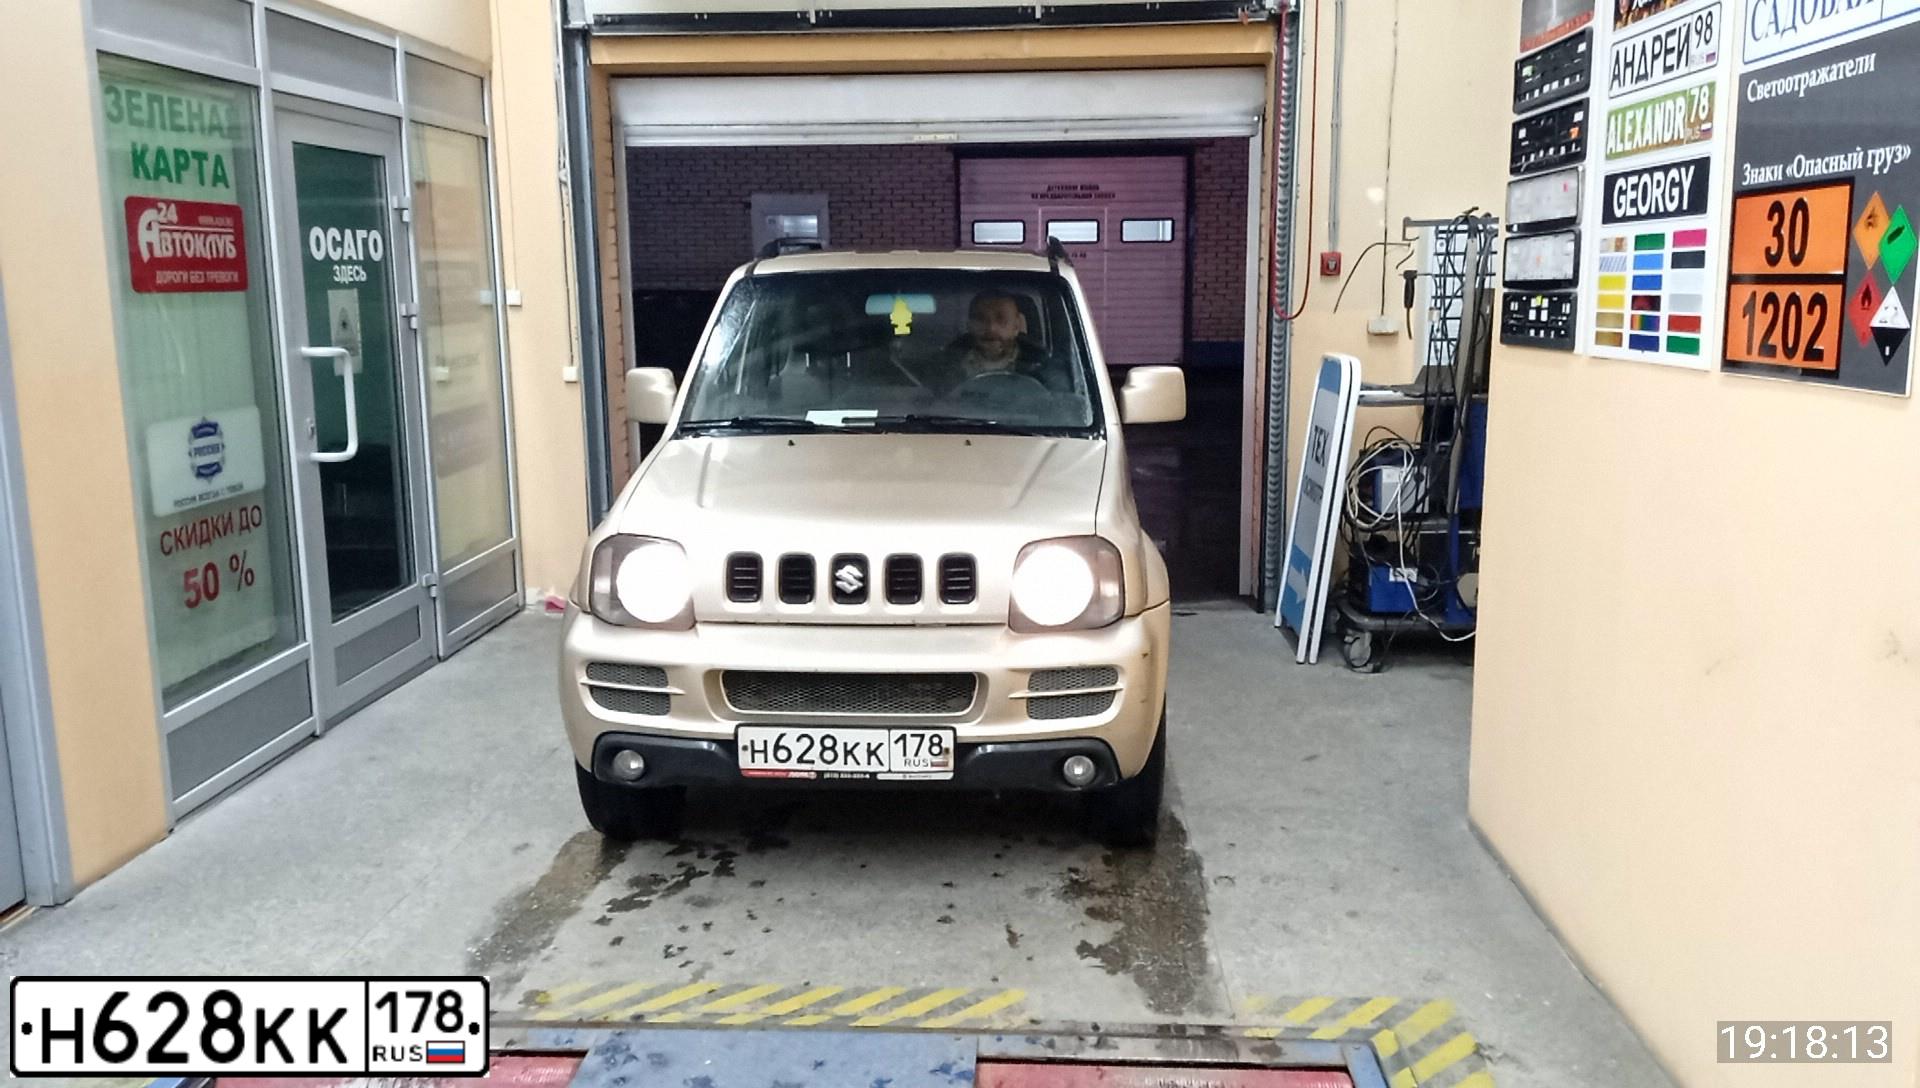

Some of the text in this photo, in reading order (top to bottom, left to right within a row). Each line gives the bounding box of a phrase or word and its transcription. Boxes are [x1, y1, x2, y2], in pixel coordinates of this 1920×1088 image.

[1751, 0, 1874, 42] САДО
[1609, 22, 1692, 91] АНДРЕЙ
[1695, 10, 1714, 49] 98
[1747, 53, 1877, 102] Светоотражатели
[1606, 85, 1710, 156] ALEXANDR 78
[131, 141, 230, 189] КАРТА
[1742, 144, 1912, 186] Знаки «Опасный груз»
[1613, 165, 1695, 218] GEORGY
[309, 226, 384, 262] ОСАГО
[1764, 196, 1811, 267] 30
[333, 265, 367, 283] ЗДЕСЬ
[1742, 290, 1828, 362] 1202
[160, 504, 263, 556] СКИДКИ ДО
[183, 550, 254, 609] 50 %
[894, 733, 943, 758] 178
[904, 758, 930, 767] RUS
